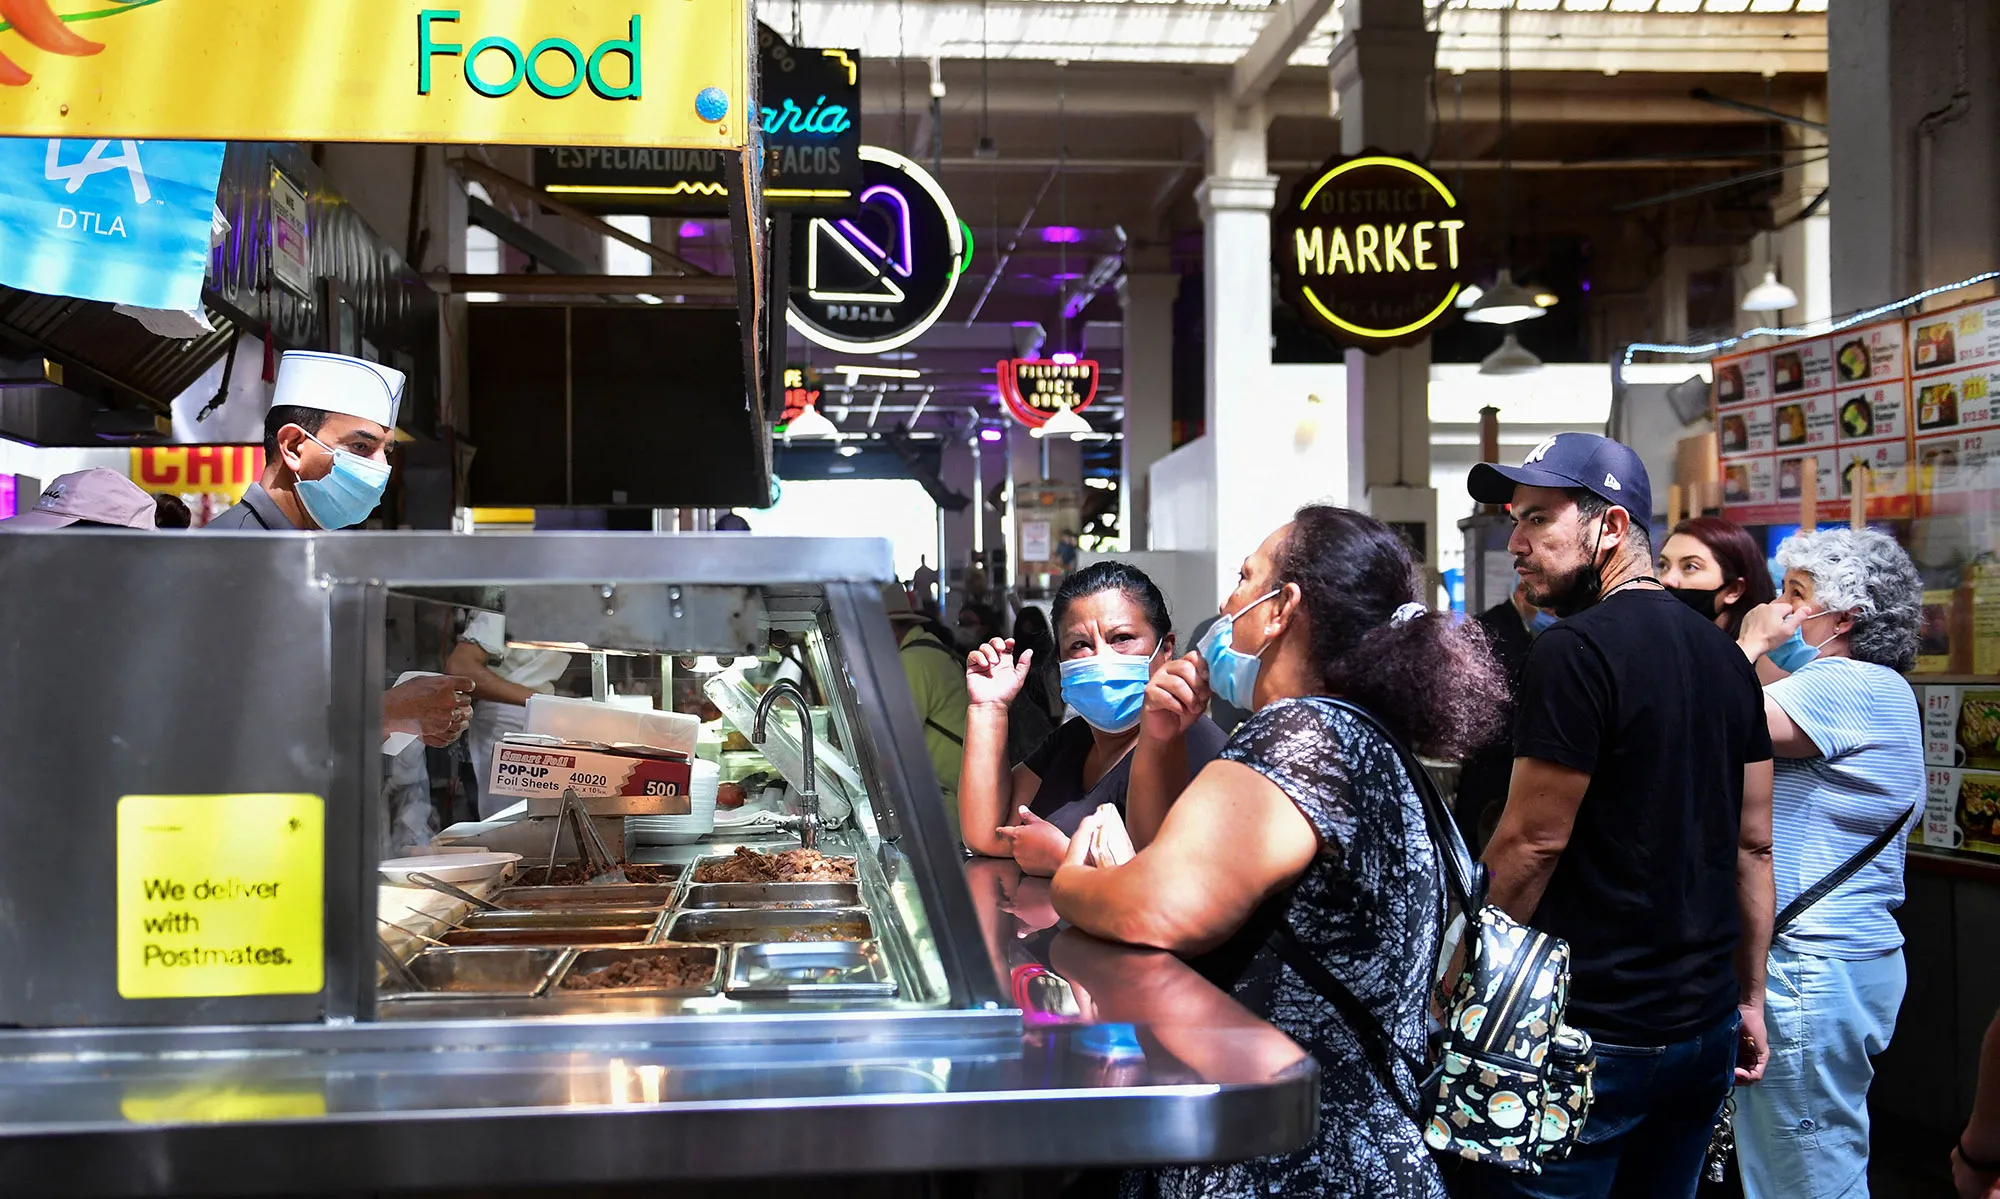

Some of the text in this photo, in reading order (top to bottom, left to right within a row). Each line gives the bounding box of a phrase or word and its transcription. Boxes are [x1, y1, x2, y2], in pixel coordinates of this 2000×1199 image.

[417, 9, 642, 100] Food
[557, 145, 841, 175] ESPECIALIDAD TACOS
[1320, 188, 1429, 214] DISTRICT
[57, 208, 127, 238] DTLA
[1295, 220, 1465, 276] MARKET
[1019, 365, 1090, 379] FILIPINO
[1036, 379, 1074, 394] RICE
[1929, 696, 1949, 710] #17
[1929, 742, 1949, 752] $7.50
[501, 751, 569, 768] Smart Foil
[499, 764, 549, 778] POP-UP
[569, 772, 607, 786] 40020
[1929, 771, 1950, 785] #19
[497, 775, 518, 787] Foil
[521, 778, 560, 791] Sheets
[646, 781, 676, 796] 500
[1928, 823, 1948, 834] $8.25
[143, 879, 280, 901] We deliver
[144, 912, 200, 933] with
[144, 944, 293, 968] Postmates.
